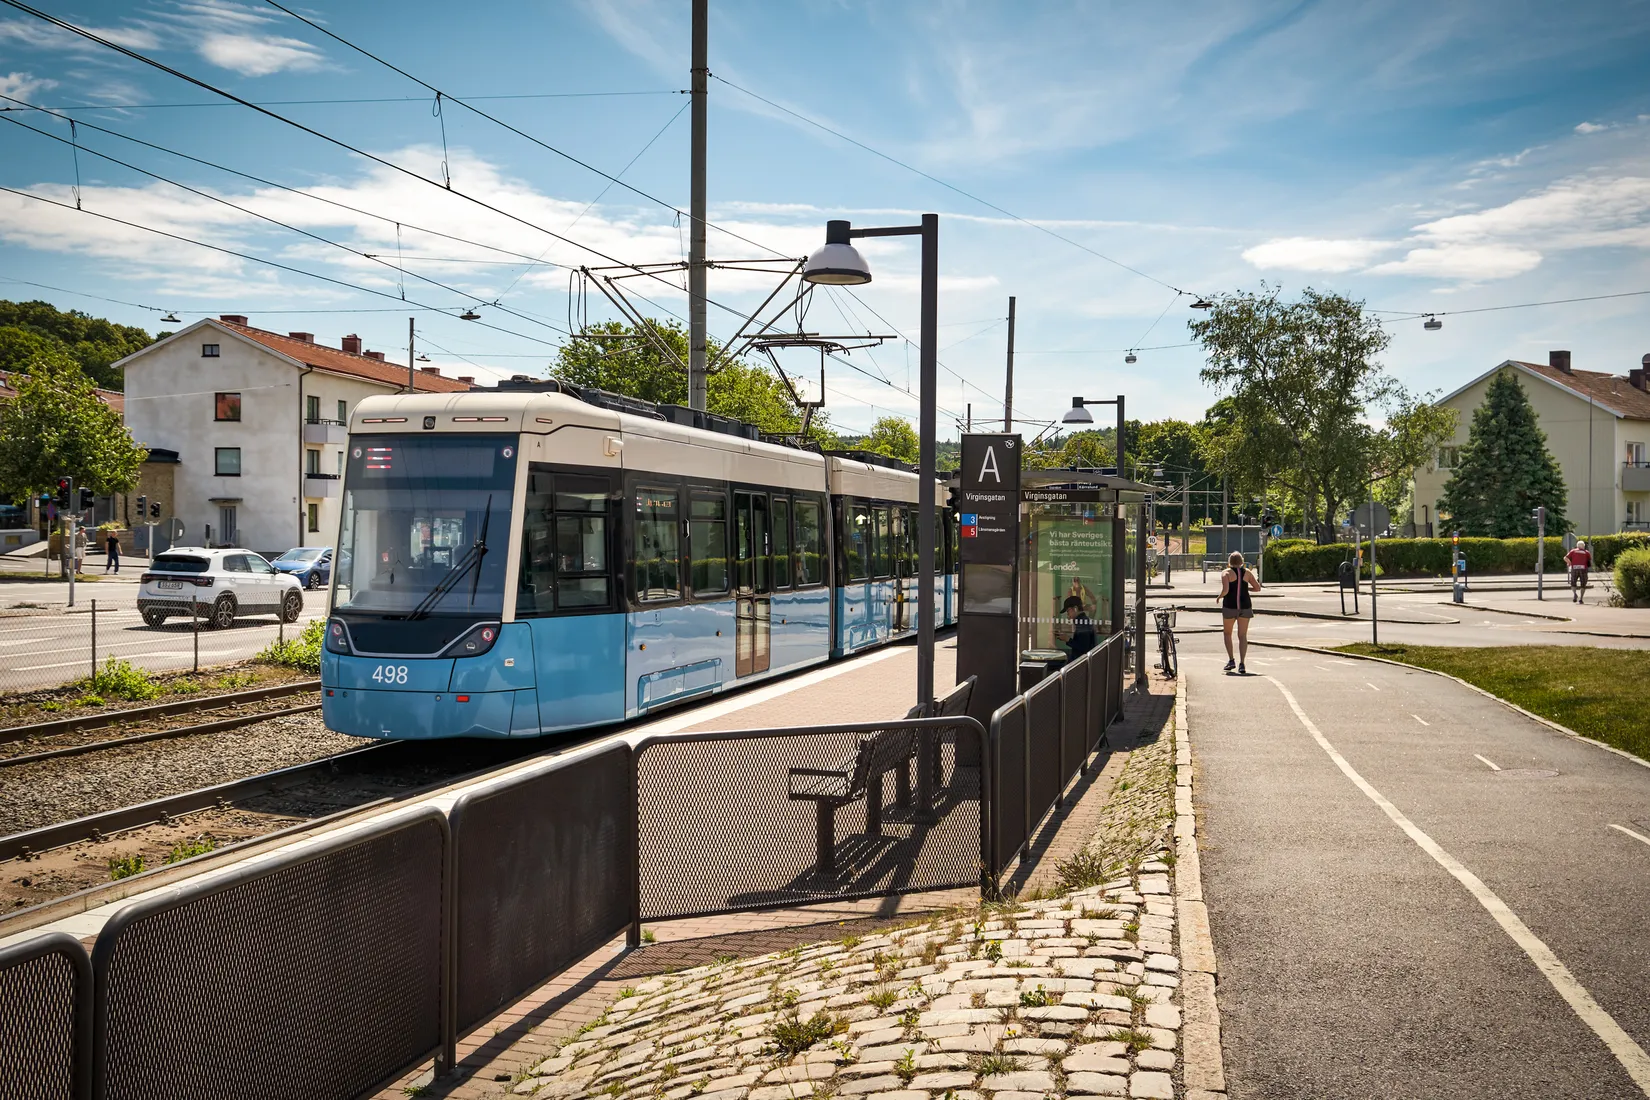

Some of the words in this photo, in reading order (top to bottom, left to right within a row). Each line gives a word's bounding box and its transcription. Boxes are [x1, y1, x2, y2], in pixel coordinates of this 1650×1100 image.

[978, 445, 1001, 482] A
[965, 492, 1006, 502] Virginsgatan
[1024, 491, 1067, 501] Virginsgatan
[970, 516, 976, 524] 3
[970, 528, 976, 536] 5
[1072, 531, 1104, 540] Sveriges
[372, 665, 408, 684] 498
